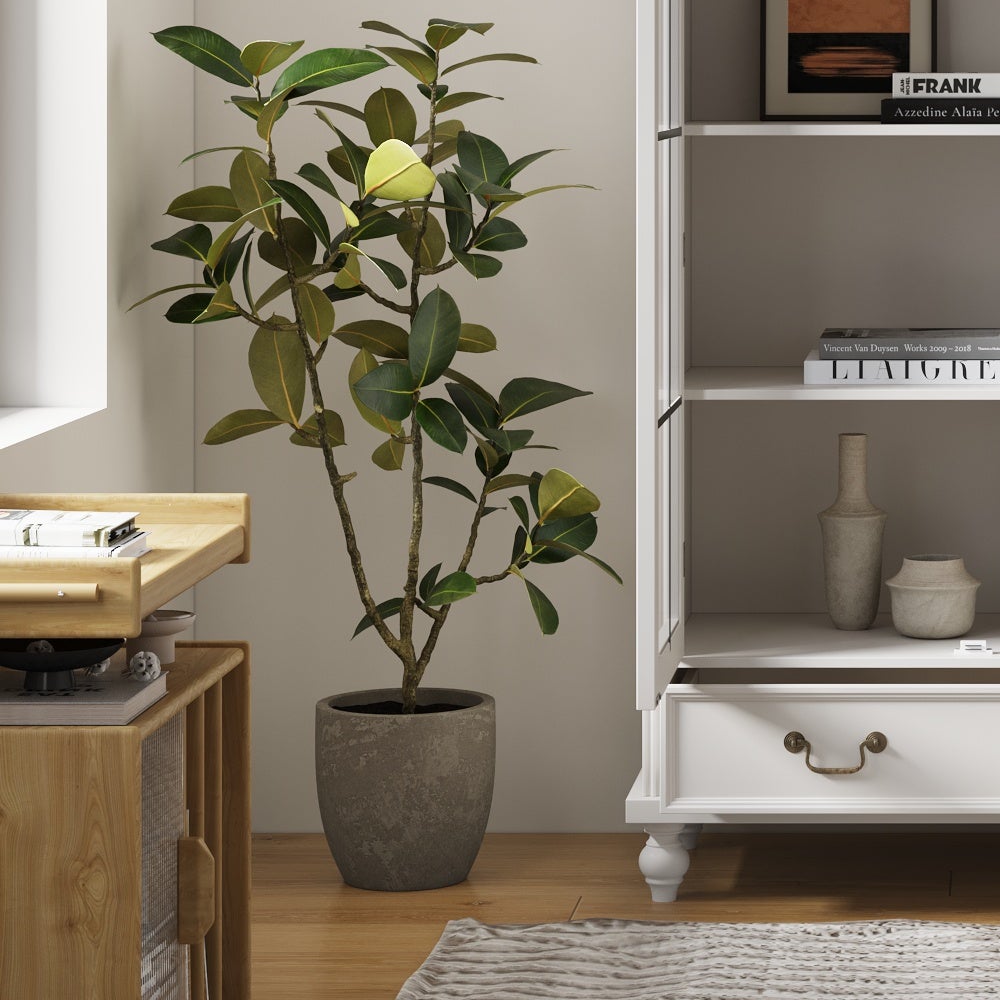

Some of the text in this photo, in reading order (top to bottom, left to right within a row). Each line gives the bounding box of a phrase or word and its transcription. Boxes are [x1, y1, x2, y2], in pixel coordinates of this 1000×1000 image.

[912, 78, 982, 94] FRANK
[894, 106, 948, 118] Azzedine
[951, 106, 983, 118] Alaïa
[823, 343, 853, 352] Vincent
[854, 343, 869, 352] Van
[870, 343, 899, 354] Duysen
[903, 343, 928, 352] Works
